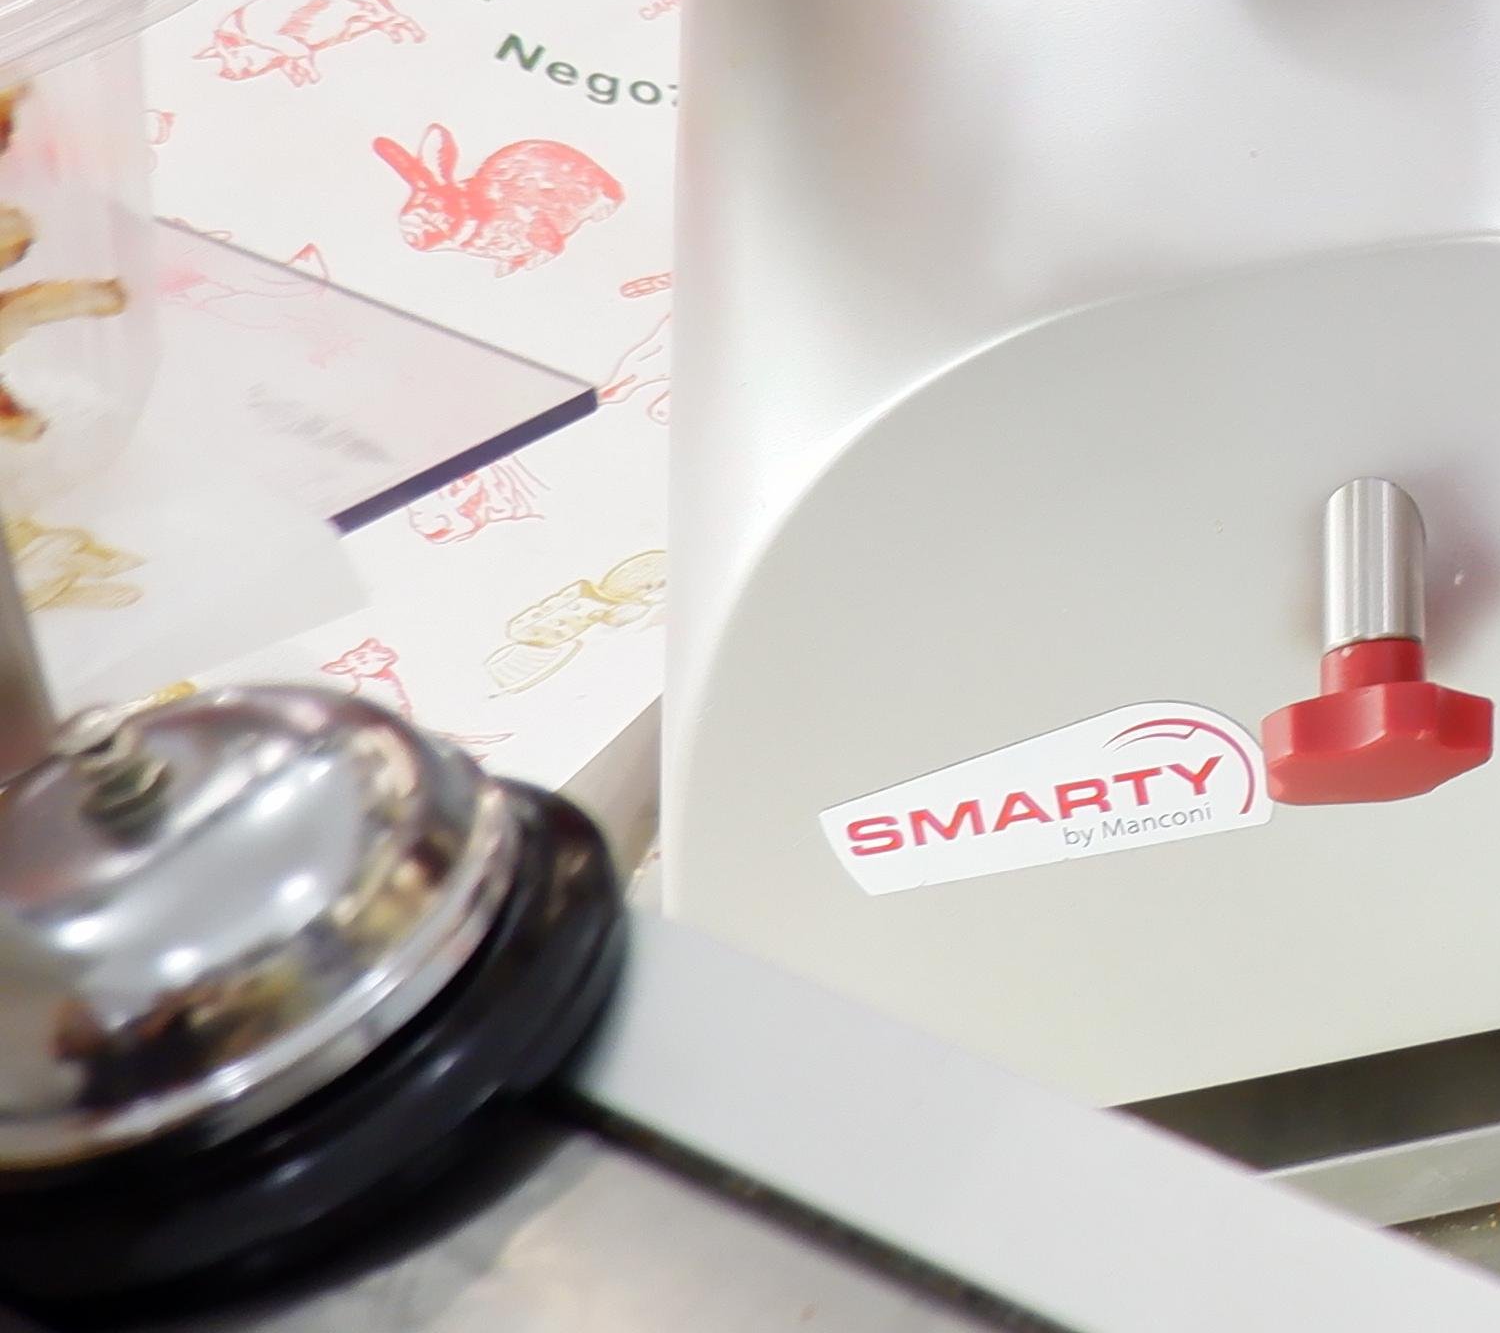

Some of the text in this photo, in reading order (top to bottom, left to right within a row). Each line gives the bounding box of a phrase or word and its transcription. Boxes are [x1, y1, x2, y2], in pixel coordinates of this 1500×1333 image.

[846, 755, 1223, 856] SMARTY
[1063, 803, 1213, 848] by Manconi
